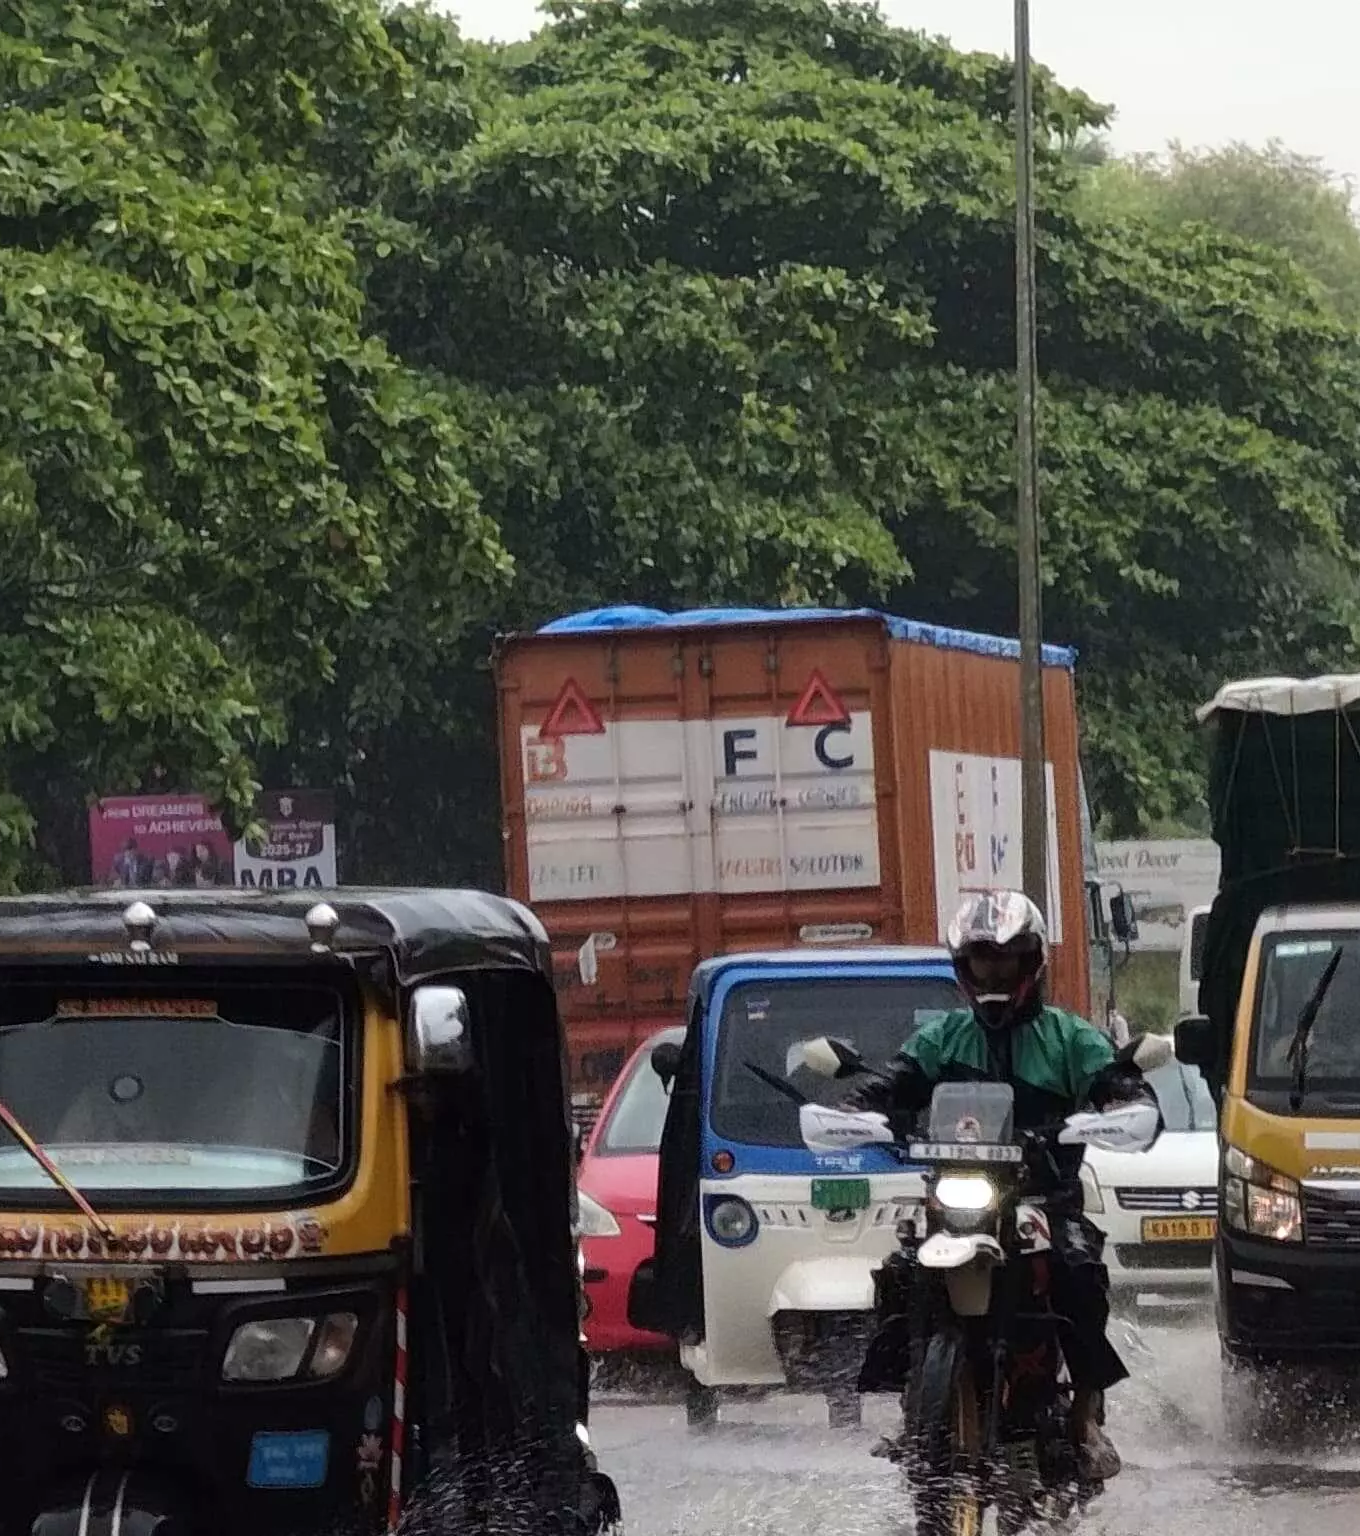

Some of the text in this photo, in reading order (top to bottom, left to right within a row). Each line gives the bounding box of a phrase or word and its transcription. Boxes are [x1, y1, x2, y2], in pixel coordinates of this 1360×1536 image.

[724, 729, 758, 776] F
[814, 725, 854, 769] C
[240, 865, 323, 888] MBA
[85, 1344, 142, 1365] TVS
